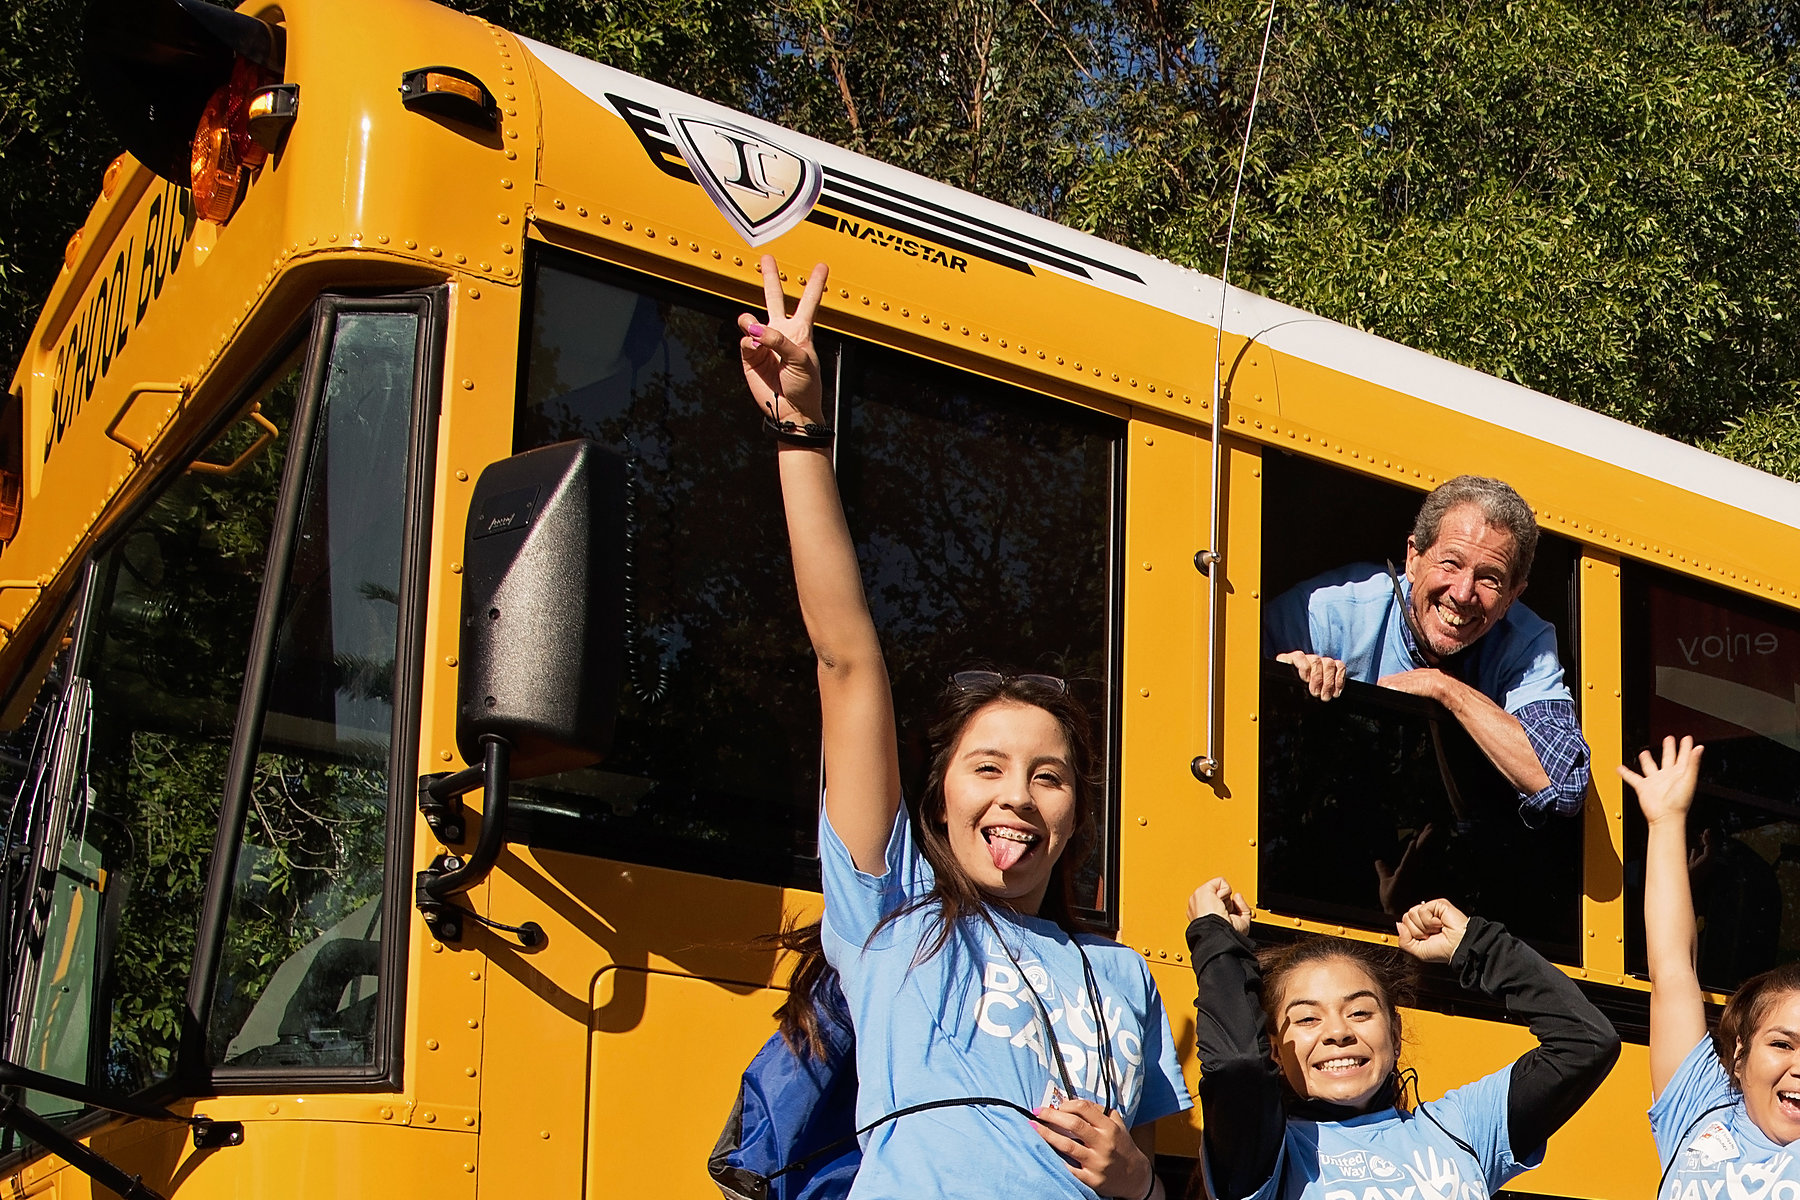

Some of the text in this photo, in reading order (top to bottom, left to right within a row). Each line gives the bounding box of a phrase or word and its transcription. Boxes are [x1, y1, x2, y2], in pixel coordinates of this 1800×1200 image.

[838, 218, 968, 273] NAVISTAR
[44, 182, 188, 464] SCHOOL BUS
[974, 991, 1141, 1113] CARIN
[1320, 1153, 1365, 1167] United
[1339, 1166, 1366, 1178] Way
